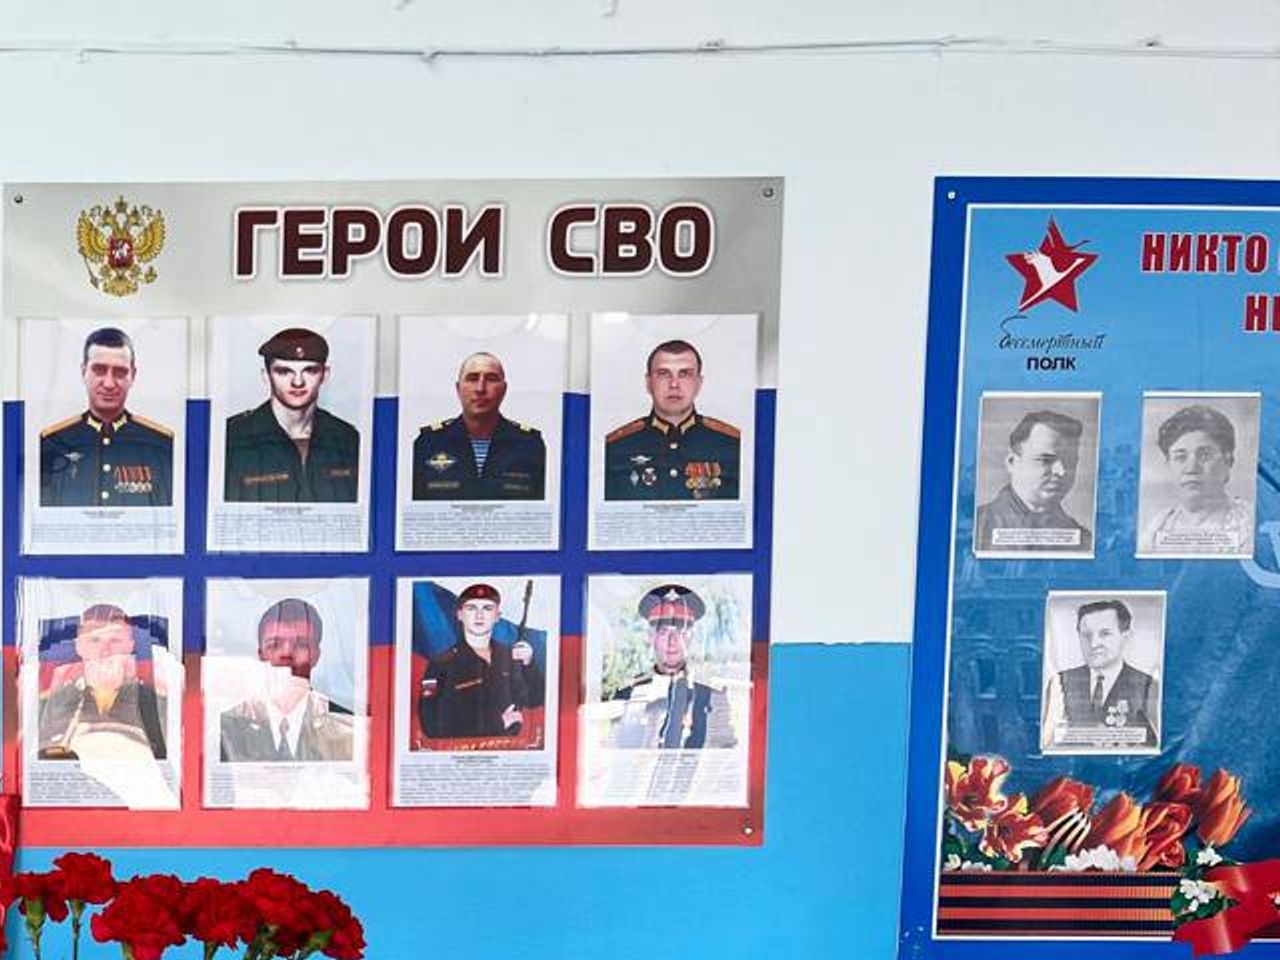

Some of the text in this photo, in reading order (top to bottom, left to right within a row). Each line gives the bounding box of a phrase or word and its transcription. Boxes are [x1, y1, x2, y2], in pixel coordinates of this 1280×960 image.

[234, 204, 715, 277] ГЕРОИ СВО
[1140, 233, 1269, 273] НИКТО
[1026, 355, 1076, 371] ПОЛК
